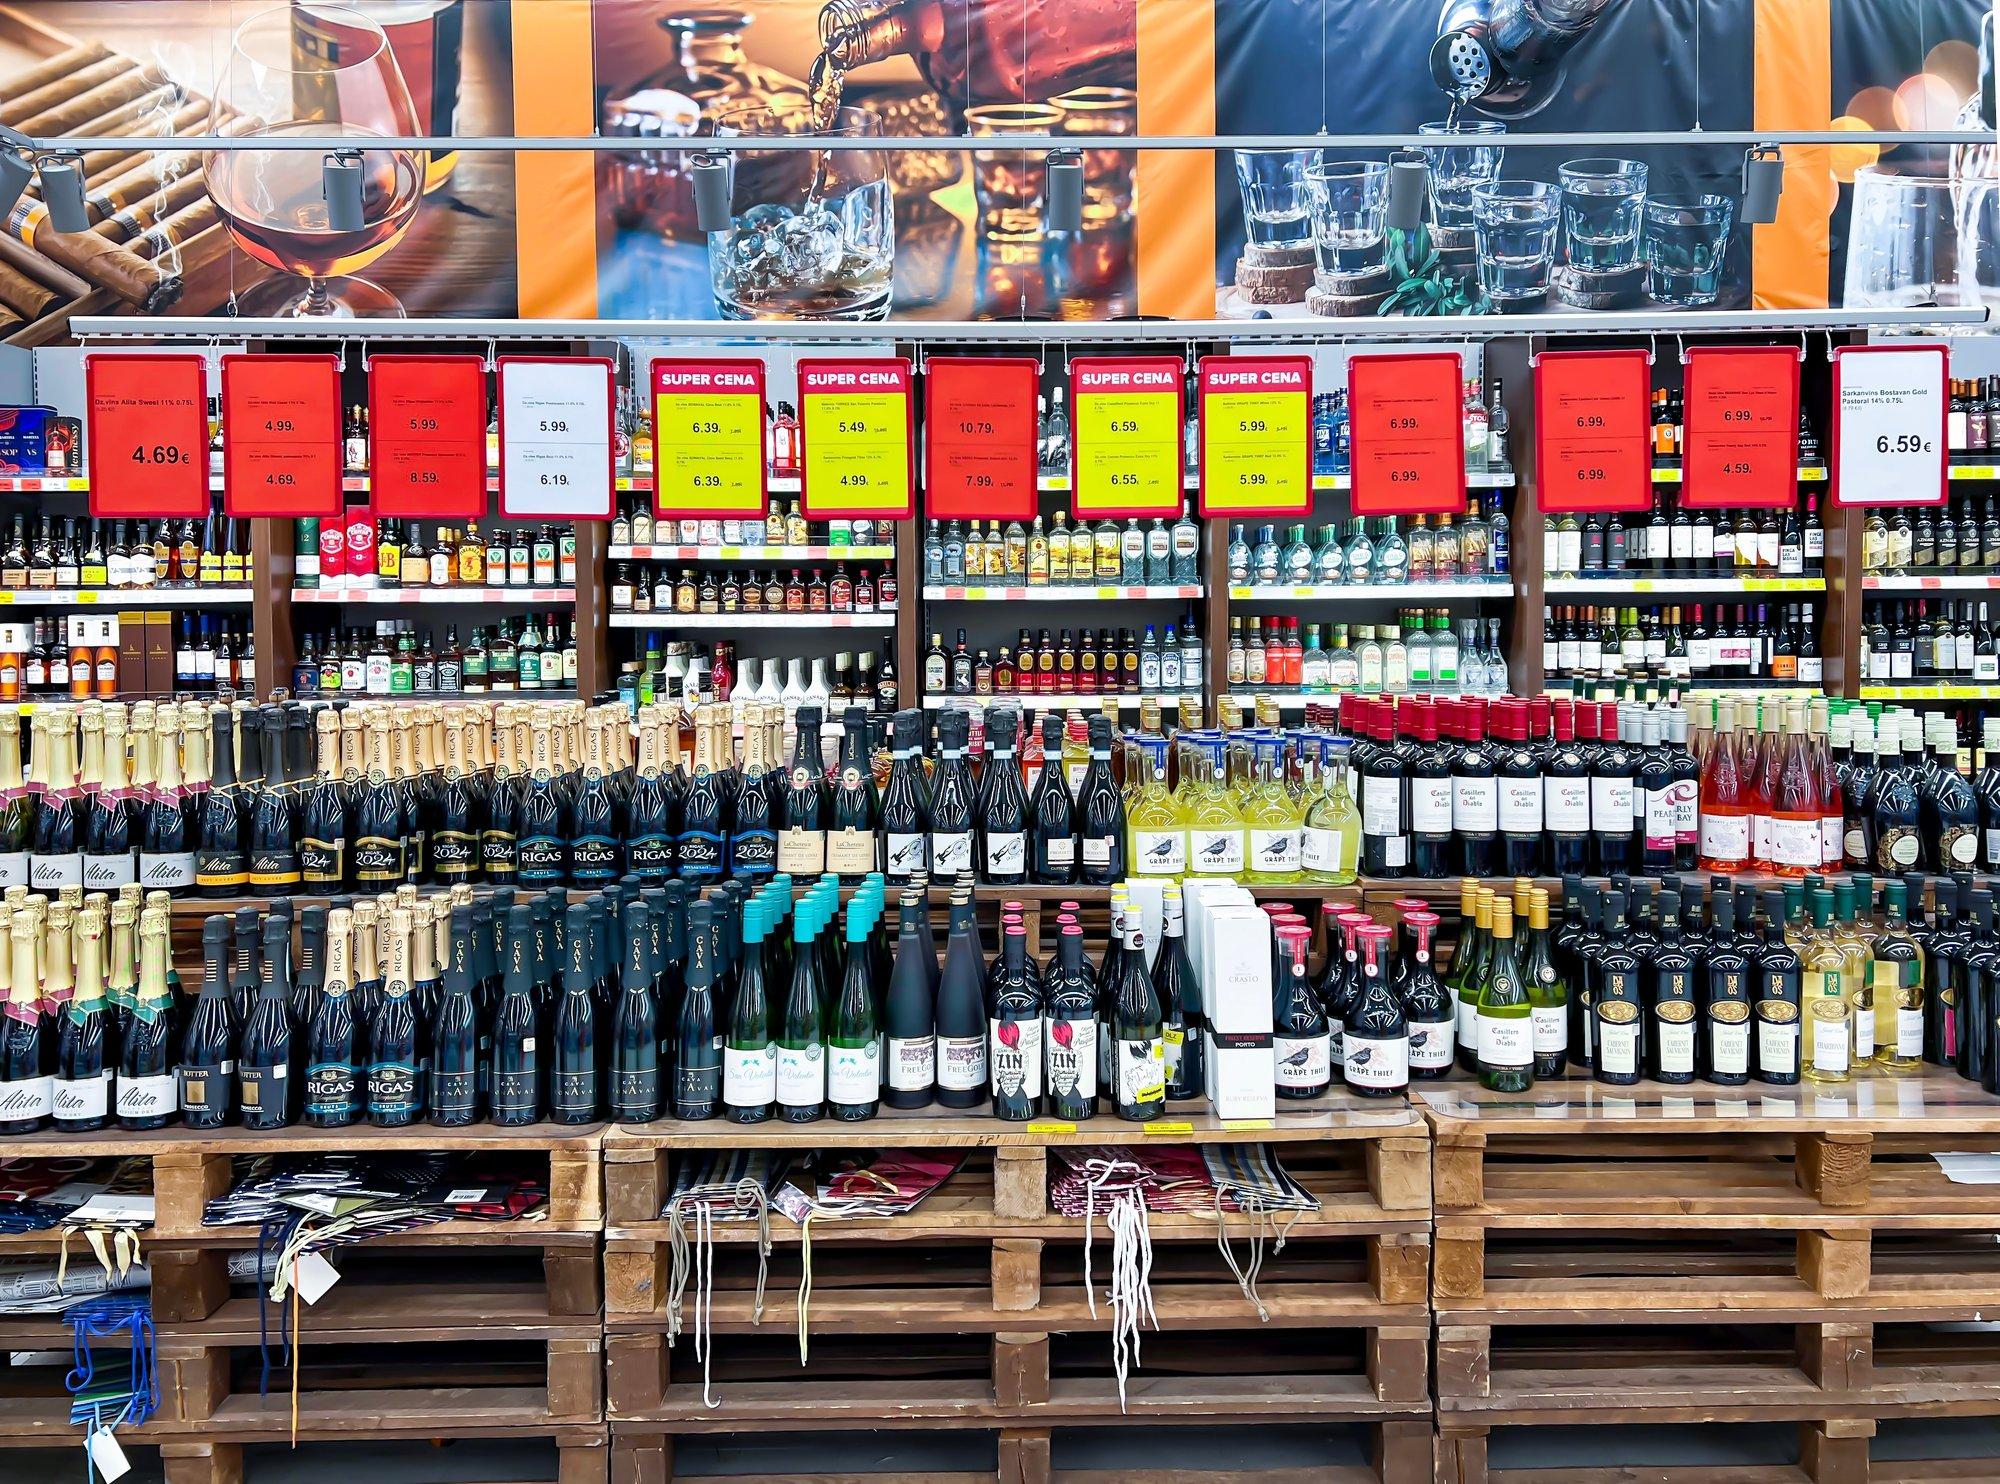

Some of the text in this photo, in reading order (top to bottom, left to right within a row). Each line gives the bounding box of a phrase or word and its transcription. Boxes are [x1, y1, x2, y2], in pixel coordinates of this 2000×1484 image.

[661, 373, 756, 386] SUPER CENA
[807, 371, 900, 386] SUPER CENA
[1081, 372, 1174, 386] SUPER CENA
[1209, 371, 1302, 385] SUPER CENA
[1842, 389, 1878, 397] Sarkanvins
[1879, 388, 1911, 396] Bostavan
[1842, 397, 1870, 405] Pastoral
[434, 845, 472, 859] 2024
[483, 845, 517, 859] 2024
[521, 850, 562, 863] RIGAS
[574, 850, 615, 862] RIGAS
[633, 849, 673, 861] RIGAS
[678, 844, 718, 860] 2024
[735, 844, 775, 859] 2024
[1149, 857, 1170, 865] GRAPE
[1264, 856, 1286, 864] GRAPE
[383, 921, 391, 953] RIGAS
[554, 919, 564, 950] CAVA
[651, 923, 659, 955] CAVA
[535, 929, 544, 962] CAVA
[695, 935, 704, 969] CAVA
[333, 938, 342, 972] RIGAS
[395, 939, 403, 973] RIGAS
[455, 939, 465, 973] CAVA
[512, 939, 521, 973] CAVA
[573, 939, 582, 973] CAVA
[632, 937, 641, 971] CAVA
[1228, 975, 1259, 984] CRASTO
[998, 1053, 1023, 1070] ZIN
[1051, 1053, 1077, 1070] ZIN
[1428, 1050, 1447, 1058] THIEF
[1282, 1067, 1308, 1077] GRAPE
[1349, 1067, 1393, 1077] GRAPE THIEF
[307, 1079, 355, 1094] RIGAS
[368, 1079, 414, 1094] RIGAS
[117, 1086, 157, 1107] Alita
